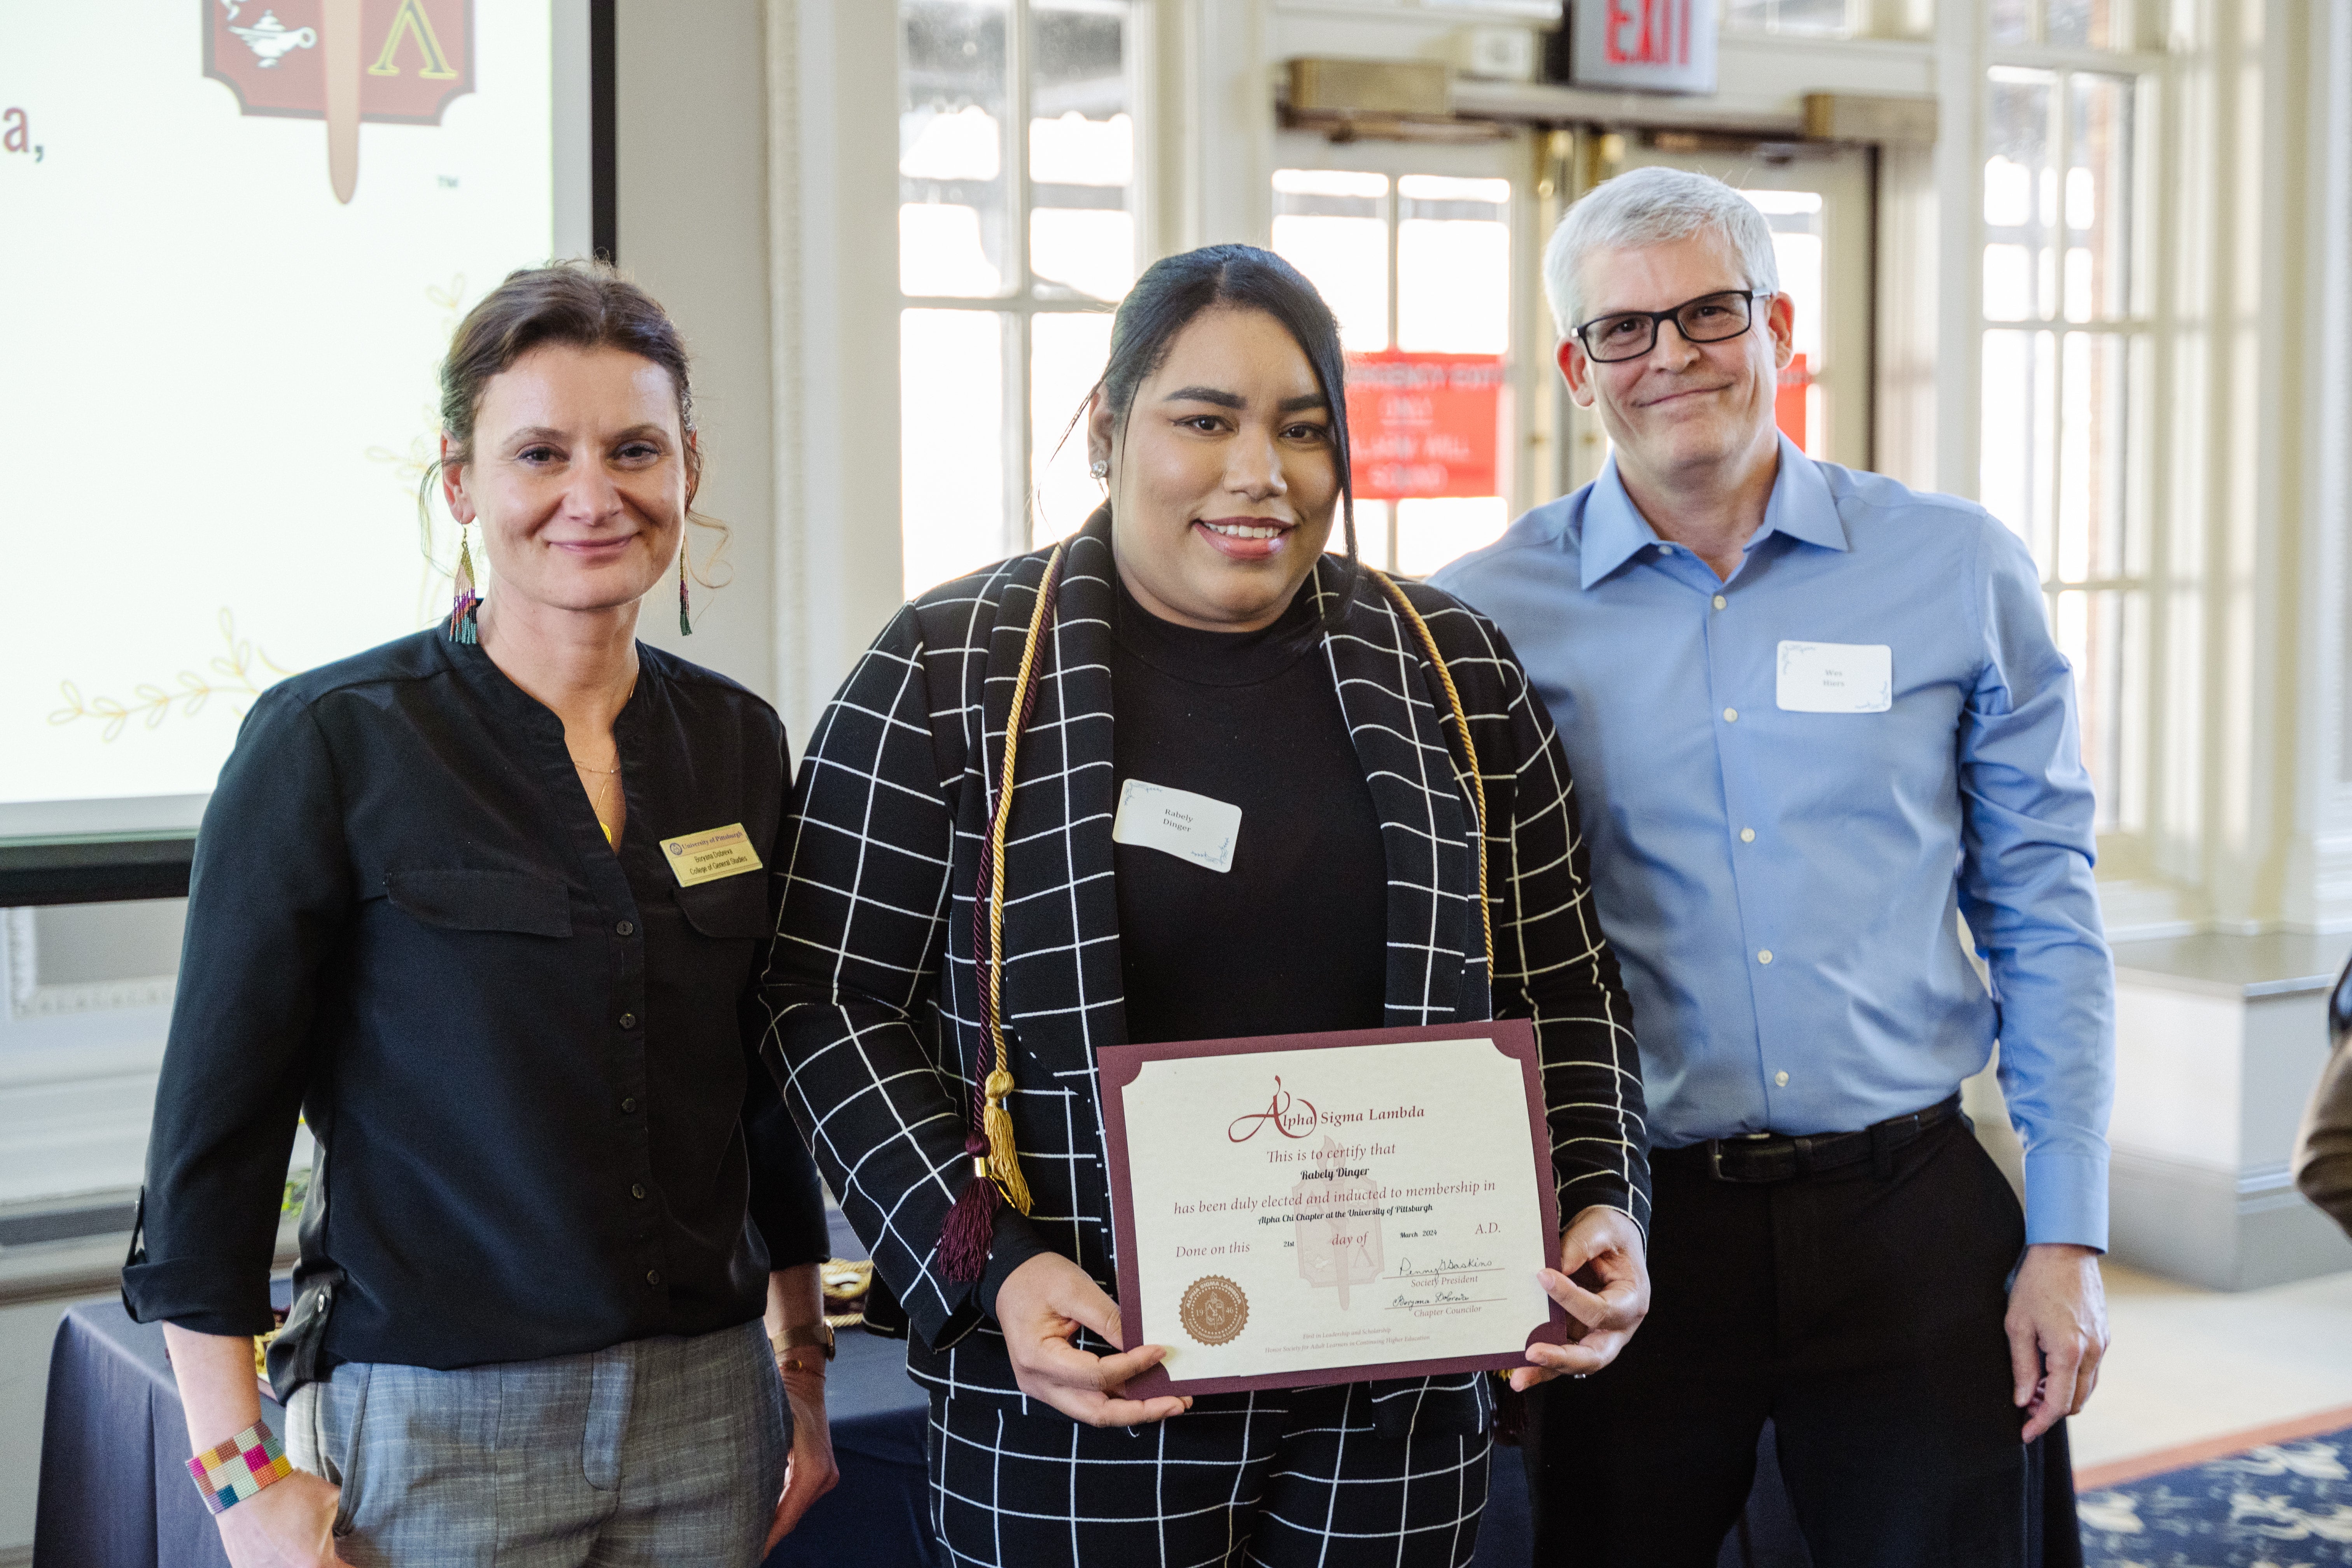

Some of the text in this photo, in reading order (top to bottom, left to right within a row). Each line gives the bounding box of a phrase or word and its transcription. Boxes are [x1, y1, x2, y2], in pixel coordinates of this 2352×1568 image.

[1165, 809, 1193, 822] Rabely
[1163, 819, 1191, 831] Dinger
[682, 840, 709, 849] University
[715, 831, 742, 842] Pittsburgh
[694, 849, 733, 863] Boryana Dobreva
[690, 866, 707, 875] College
[712, 859, 731, 869] General
[730, 856, 747, 866] Studies
[1228, 1075, 1425, 1143] Alpha Sigma Lambda
[1267, 1143, 1396, 1163] This is to certify that
[1300, 1167, 1369, 1181] Rabely Dinger
[1174, 1180, 1495, 1214] has been duly elected and inducted to membership in
[1258, 1216, 1280, 1225] Alpha
[1296, 1212, 1324, 1223] Chapter
[1335, 1210, 1346, 1218] the
[1348, 1207, 1384, 1217] University
[1387, 1206, 1395, 1216] of
[1395, 1204, 1433, 1213] Pittsburgh
[1176, 1246, 1207, 1258] Done
[1211, 1246, 1225, 1255] on
[1229, 1241, 1250, 1253] this
[1332, 1234, 1353, 1248] day
[1357, 1231, 1369, 1247] of
[1475, 1222, 1501, 1235] A.D.
[1411, 1275, 1478, 1288] Society President
[1186, 1288, 1200, 1308] ALPHA
[1221, 1282, 1241, 1304] LAMBDA
[1414, 1306, 1482, 1318] Chapter Councilor
